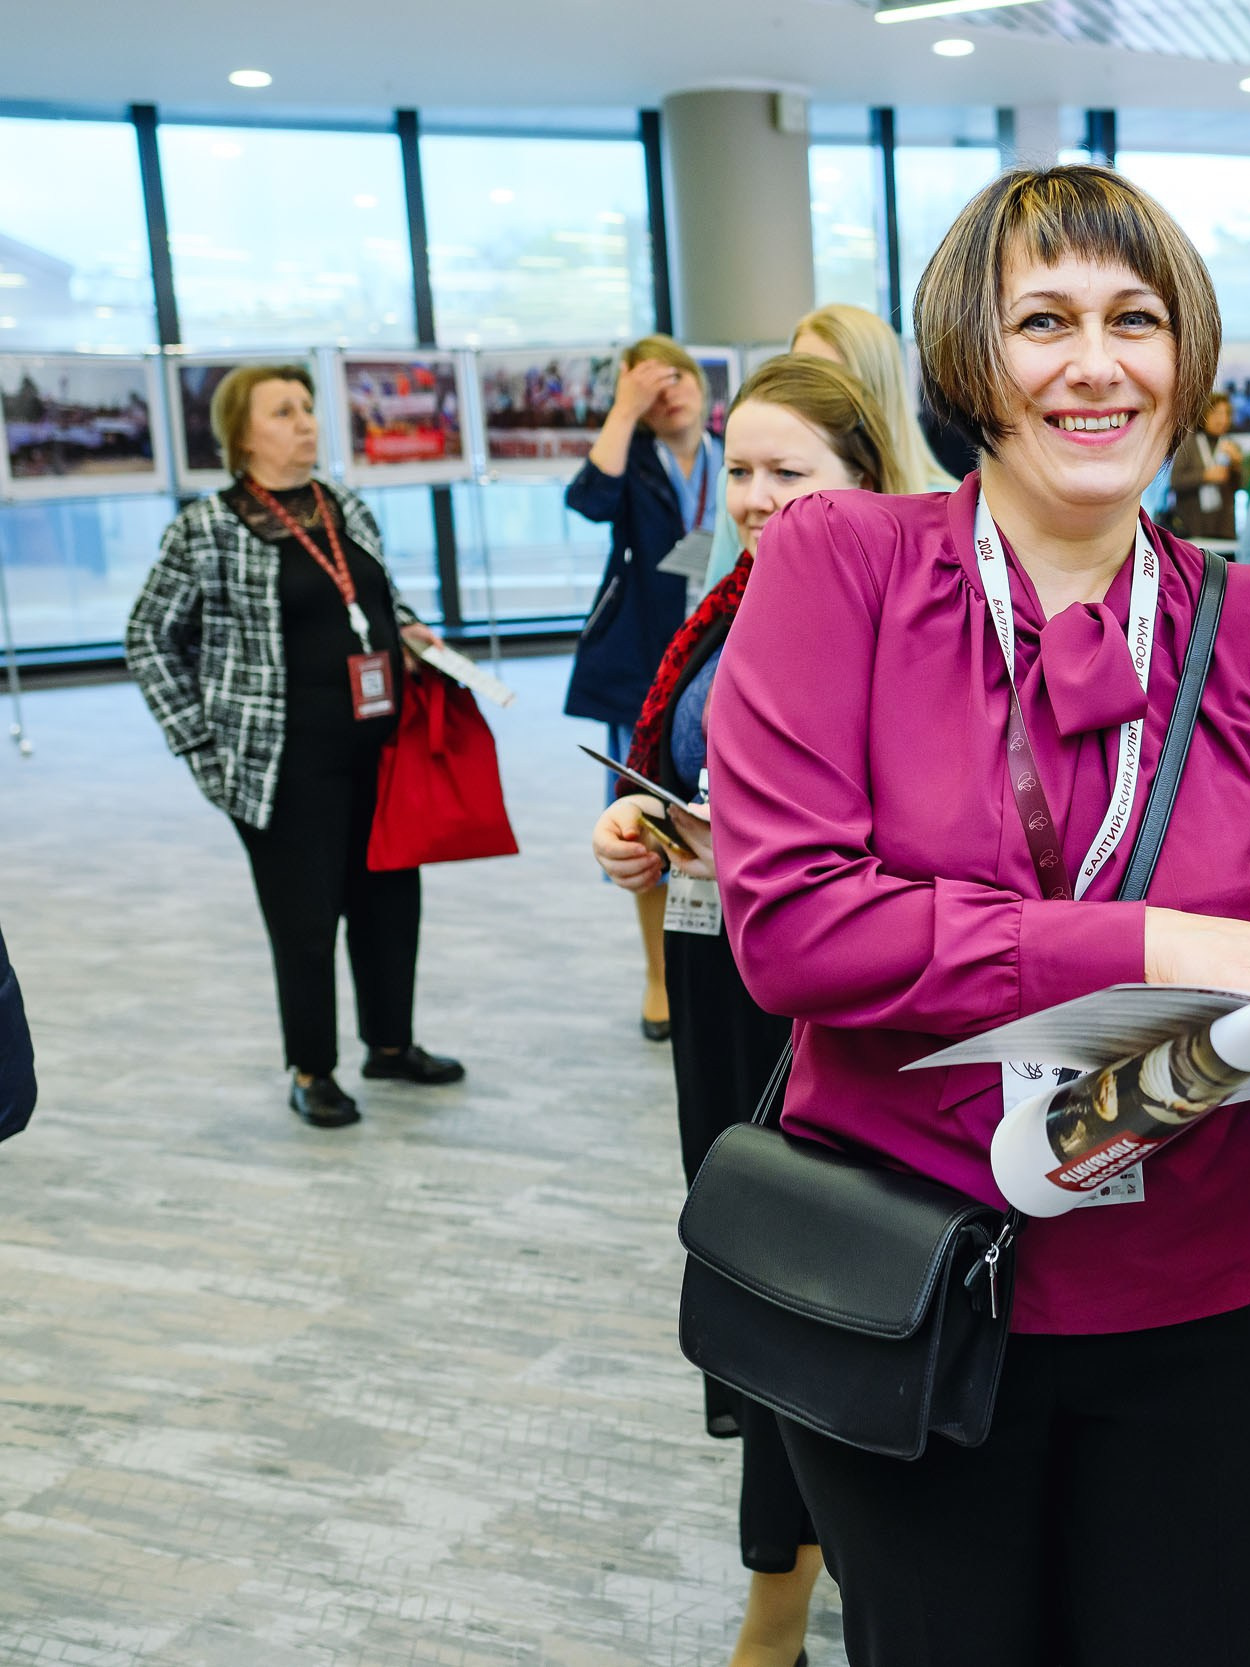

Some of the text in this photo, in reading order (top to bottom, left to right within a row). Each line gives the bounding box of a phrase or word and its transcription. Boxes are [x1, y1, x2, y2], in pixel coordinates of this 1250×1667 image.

[977, 537, 995, 562] 2024
[1143, 549, 1155, 579] 2024
[1084, 771, 1134, 877] БАЛТИЙСКИЙ
[1125, 719, 1139, 770] КУЛЬТ
[1135, 616, 1149, 669] ФОРУМ
[1059, 1138, 1140, 1184] УПРАВЛЯТЬ
